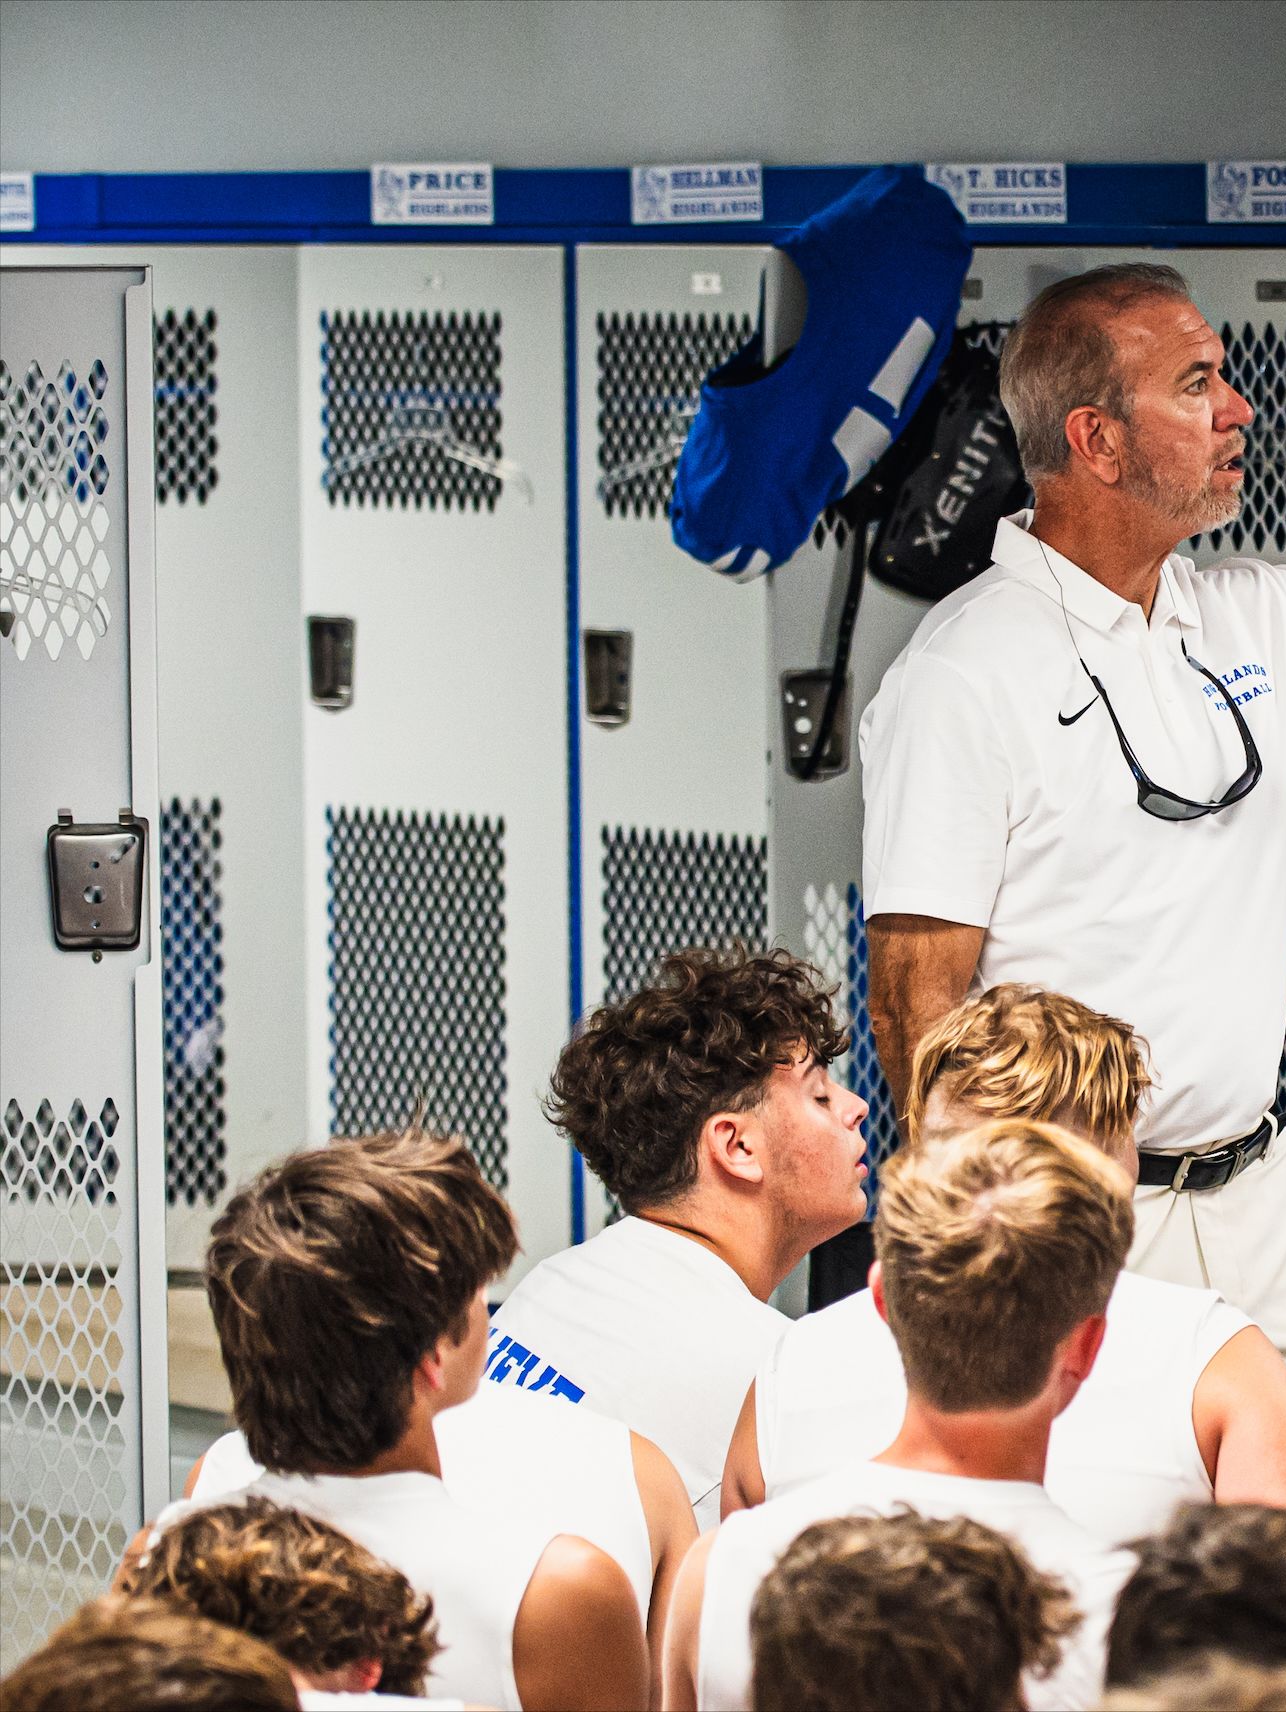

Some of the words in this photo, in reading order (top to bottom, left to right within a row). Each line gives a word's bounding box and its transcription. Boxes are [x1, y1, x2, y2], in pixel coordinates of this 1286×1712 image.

[408, 172, 487, 191] PRICE
[671, 167, 758, 189] HELLMAN
[994, 168, 1062, 189] HICKS
